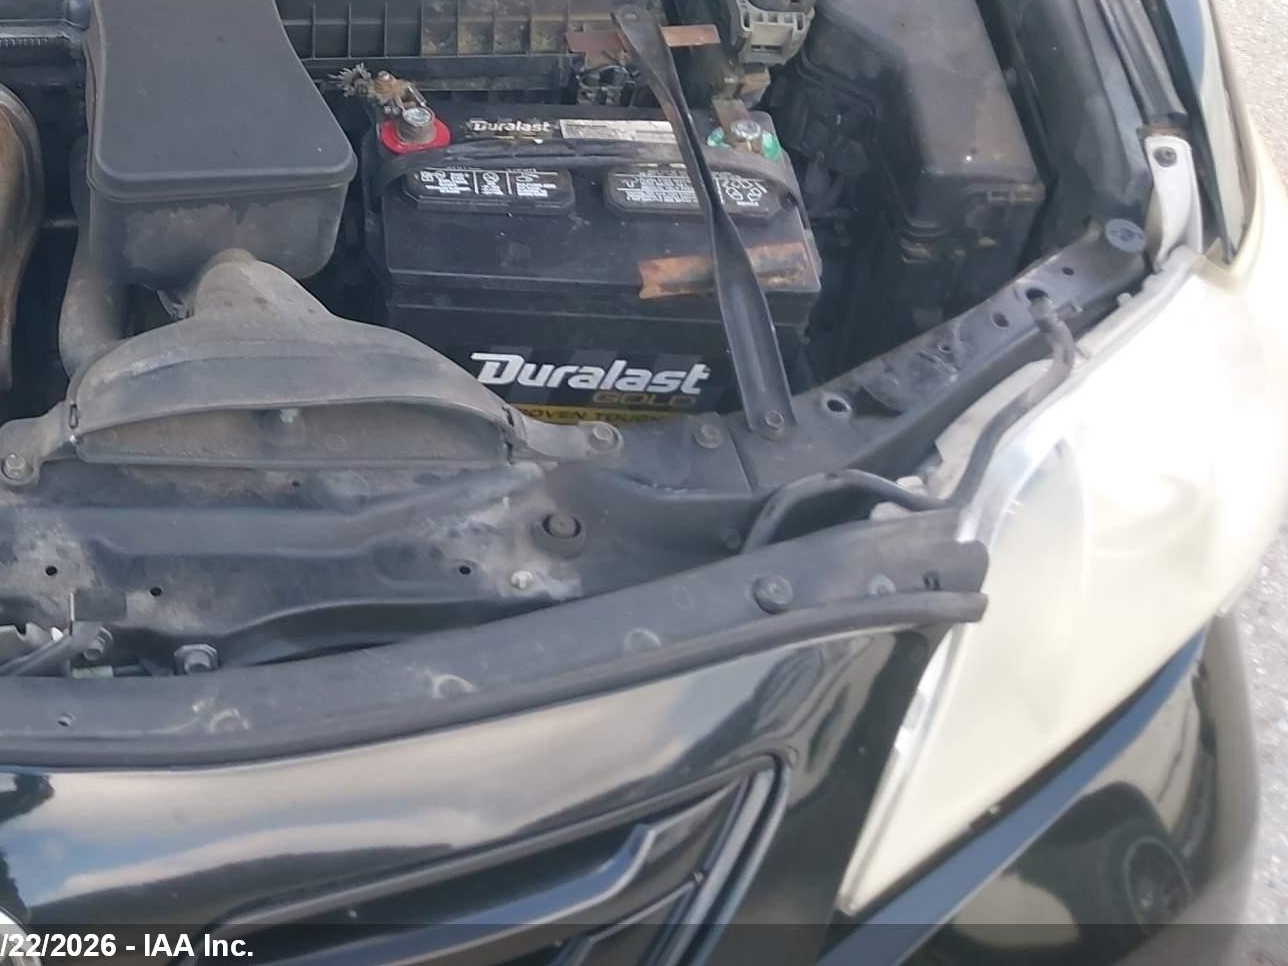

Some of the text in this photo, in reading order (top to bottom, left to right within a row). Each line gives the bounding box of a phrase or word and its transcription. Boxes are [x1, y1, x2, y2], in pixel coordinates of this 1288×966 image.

[469, 118, 552, 132] Duralast
[470, 352, 711, 395] Duralast
[592, 391, 697, 406] GOLD
